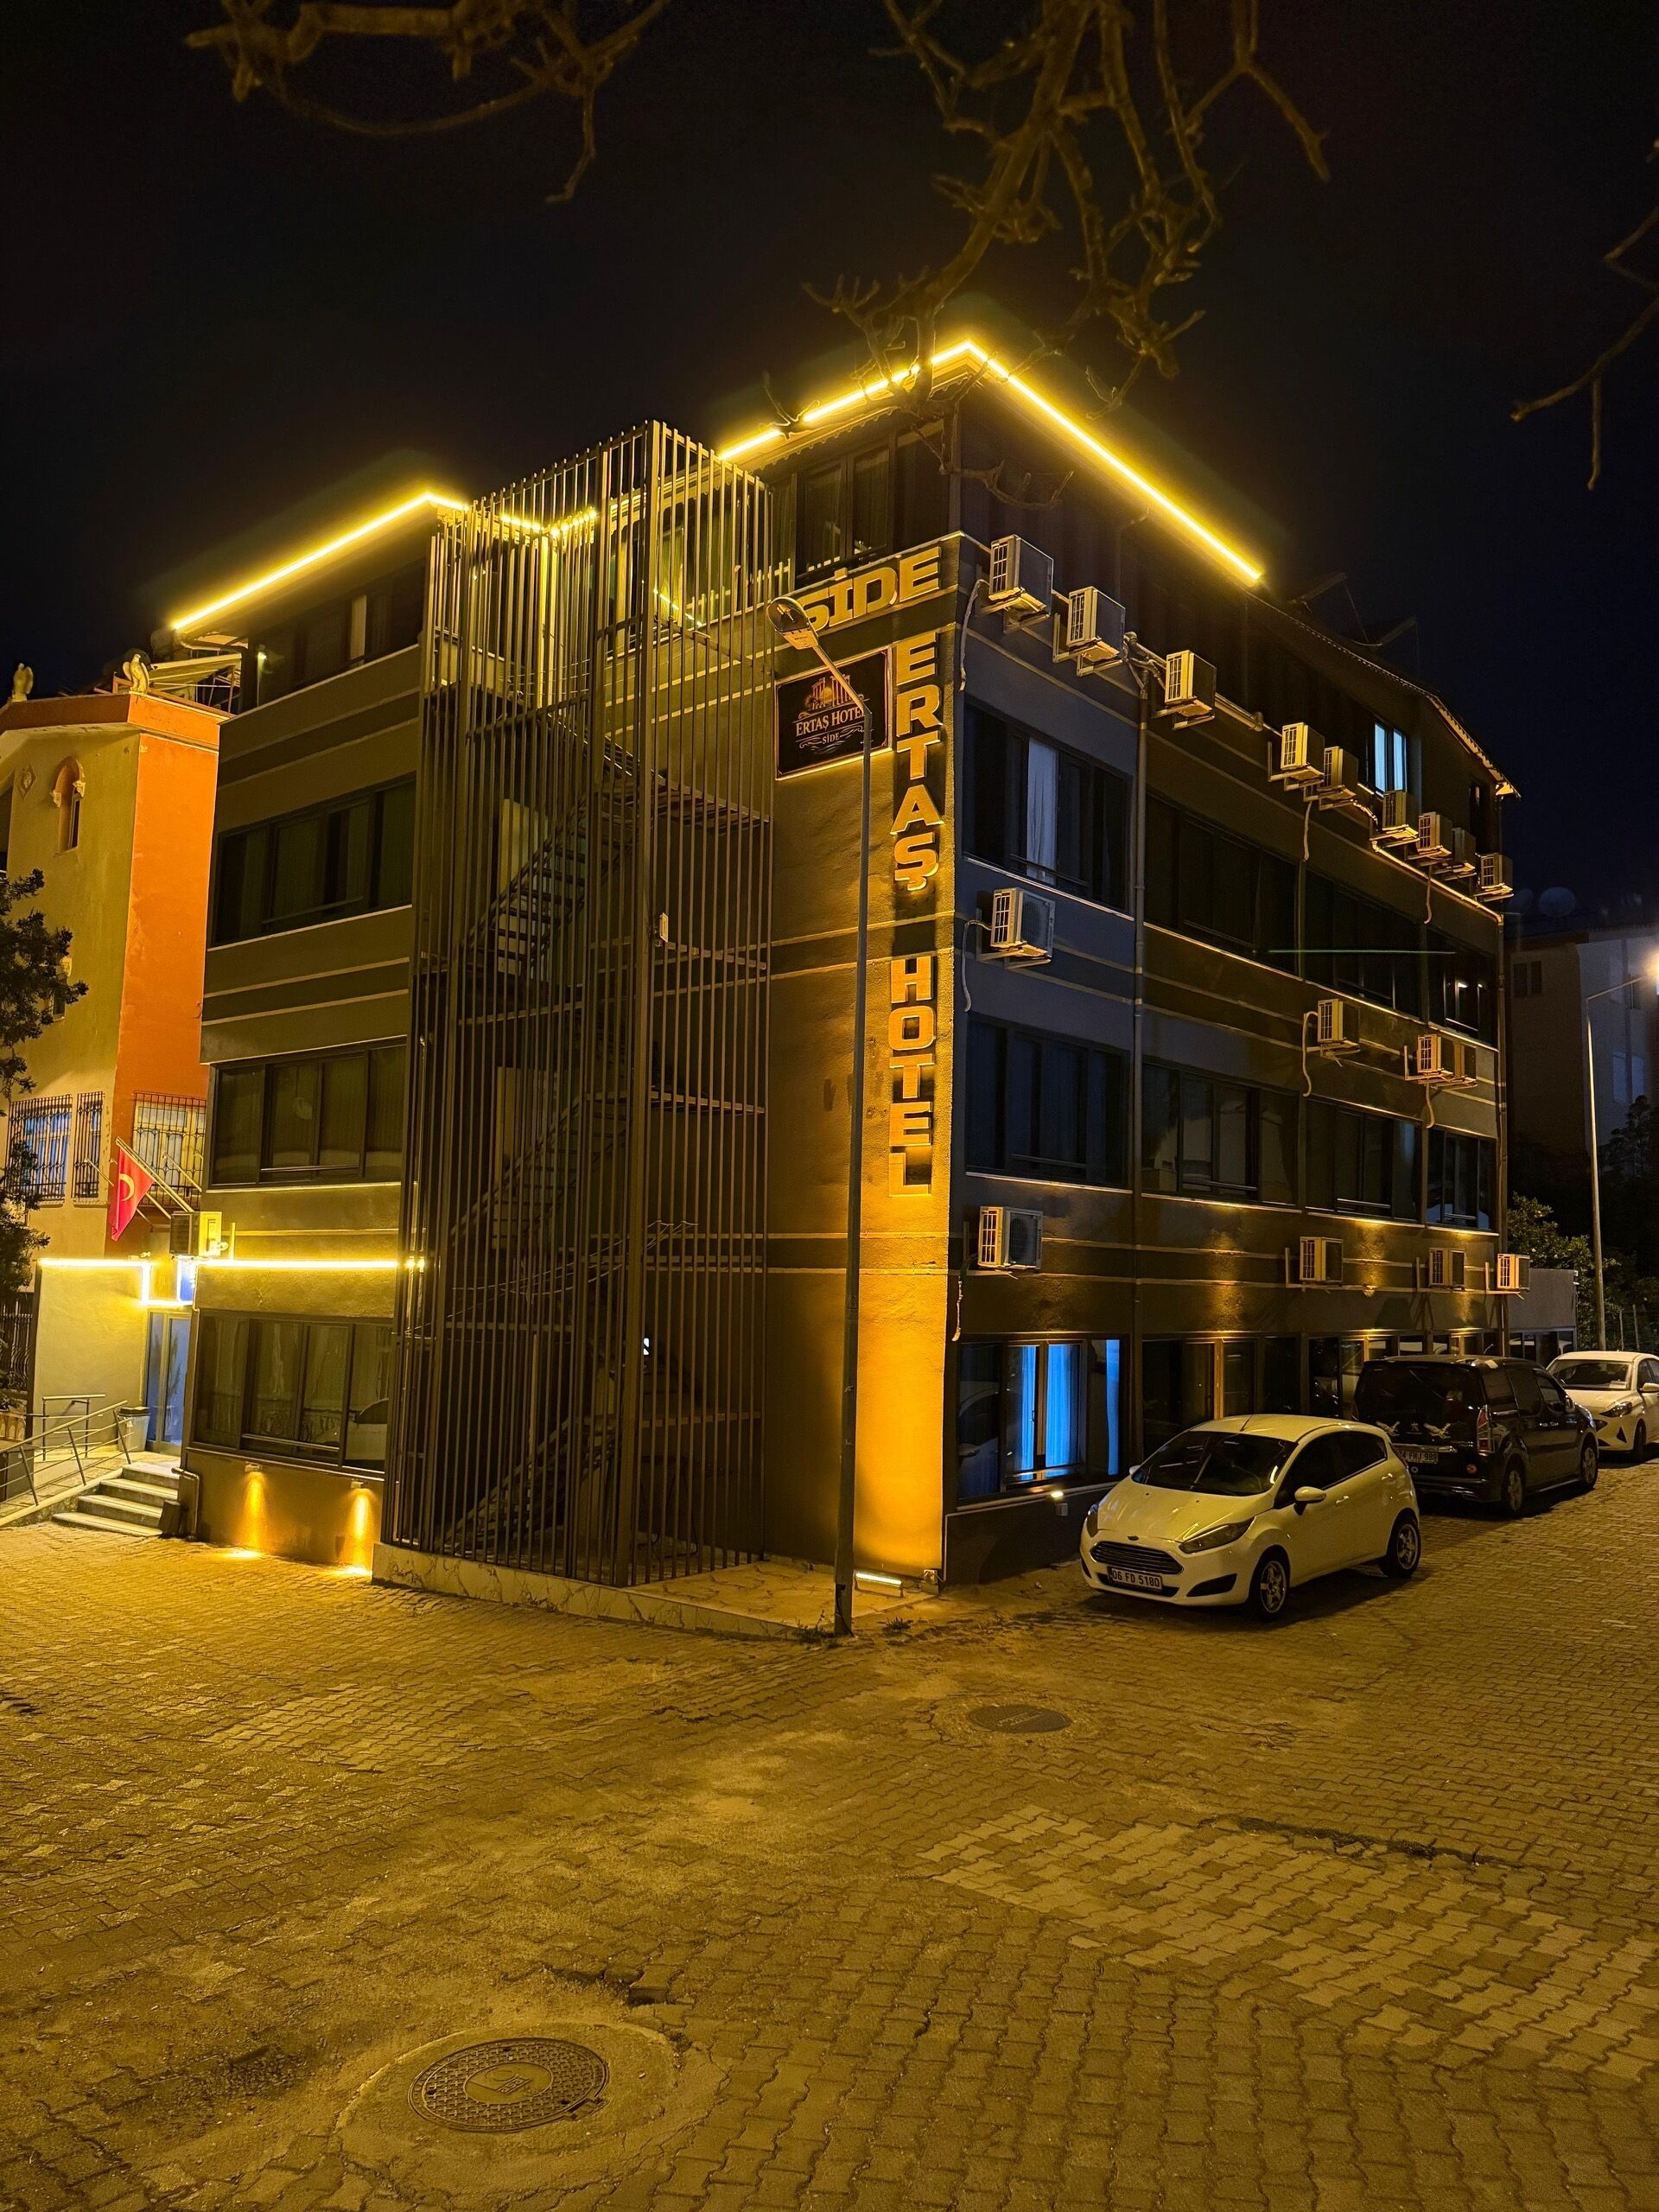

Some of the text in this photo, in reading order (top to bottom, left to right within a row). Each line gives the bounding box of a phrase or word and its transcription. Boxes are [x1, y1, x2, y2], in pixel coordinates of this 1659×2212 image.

[796, 706, 864, 737] ERTAŞ HOTE
[888, 632, 944, 1197] ERTAŞ HOTEL
[1112, 1570, 1122, 1580] 06
